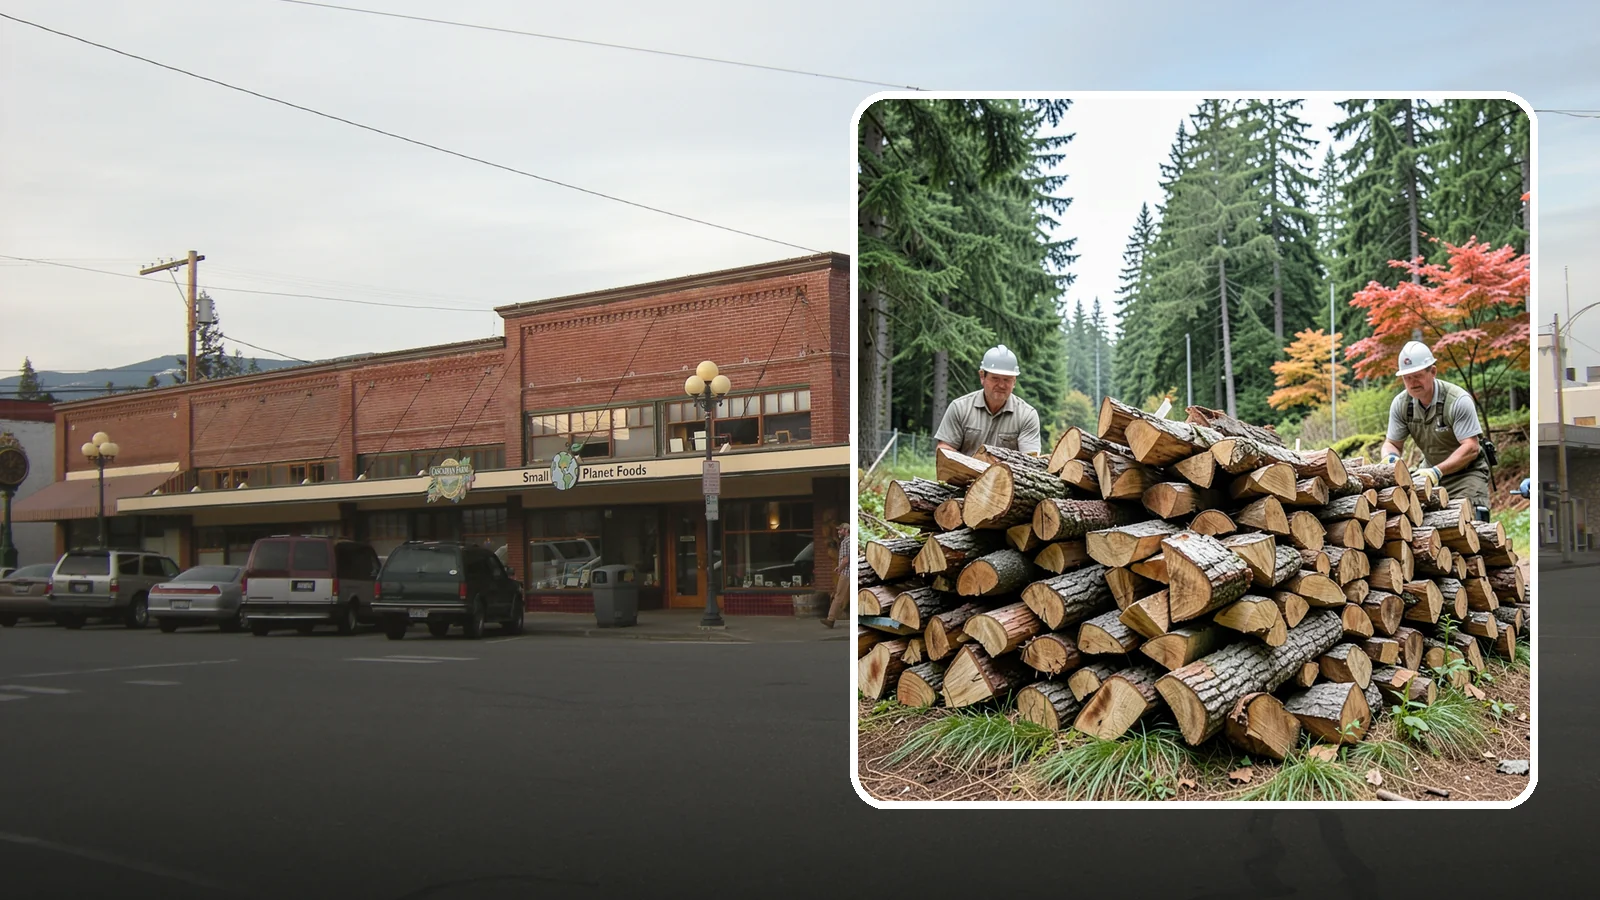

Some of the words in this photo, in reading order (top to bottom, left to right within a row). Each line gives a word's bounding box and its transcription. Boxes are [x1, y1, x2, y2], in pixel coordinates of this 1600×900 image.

[523, 471, 549, 483] Small
[583, 467, 614, 479] Planet
[617, 464, 647, 477] Foods
